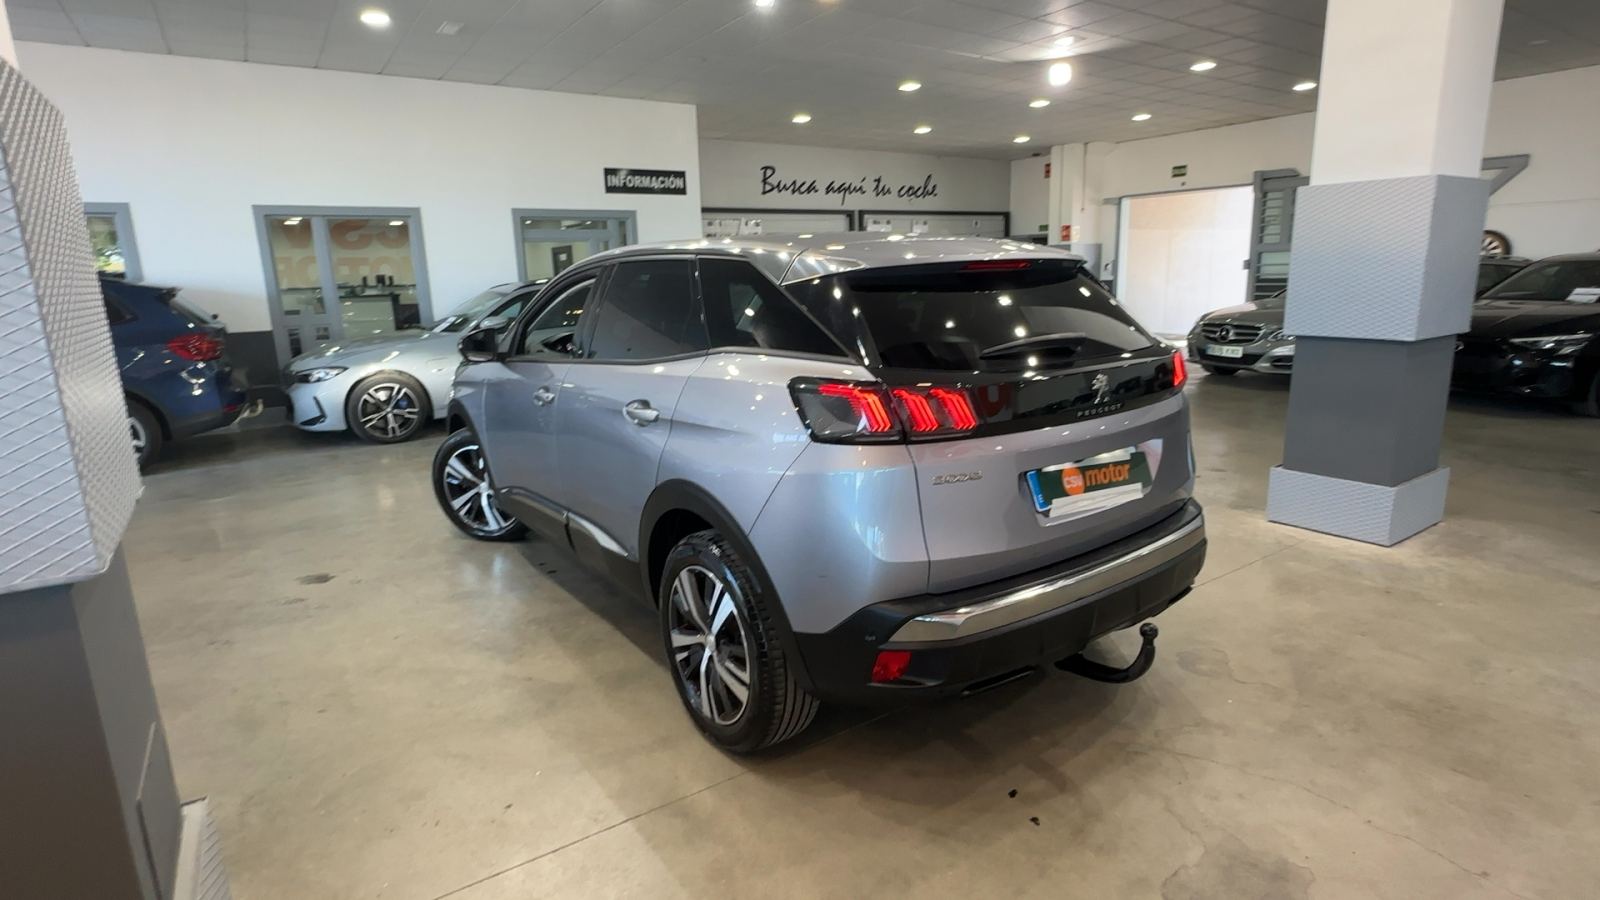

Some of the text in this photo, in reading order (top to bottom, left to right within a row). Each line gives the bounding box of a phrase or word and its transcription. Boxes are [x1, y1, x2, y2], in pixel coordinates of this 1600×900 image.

[606, 174, 685, 190] INFORMACIÓN
[760, 165, 938, 206] Busca aquí tu coche
[1085, 463, 1130, 487] motor
